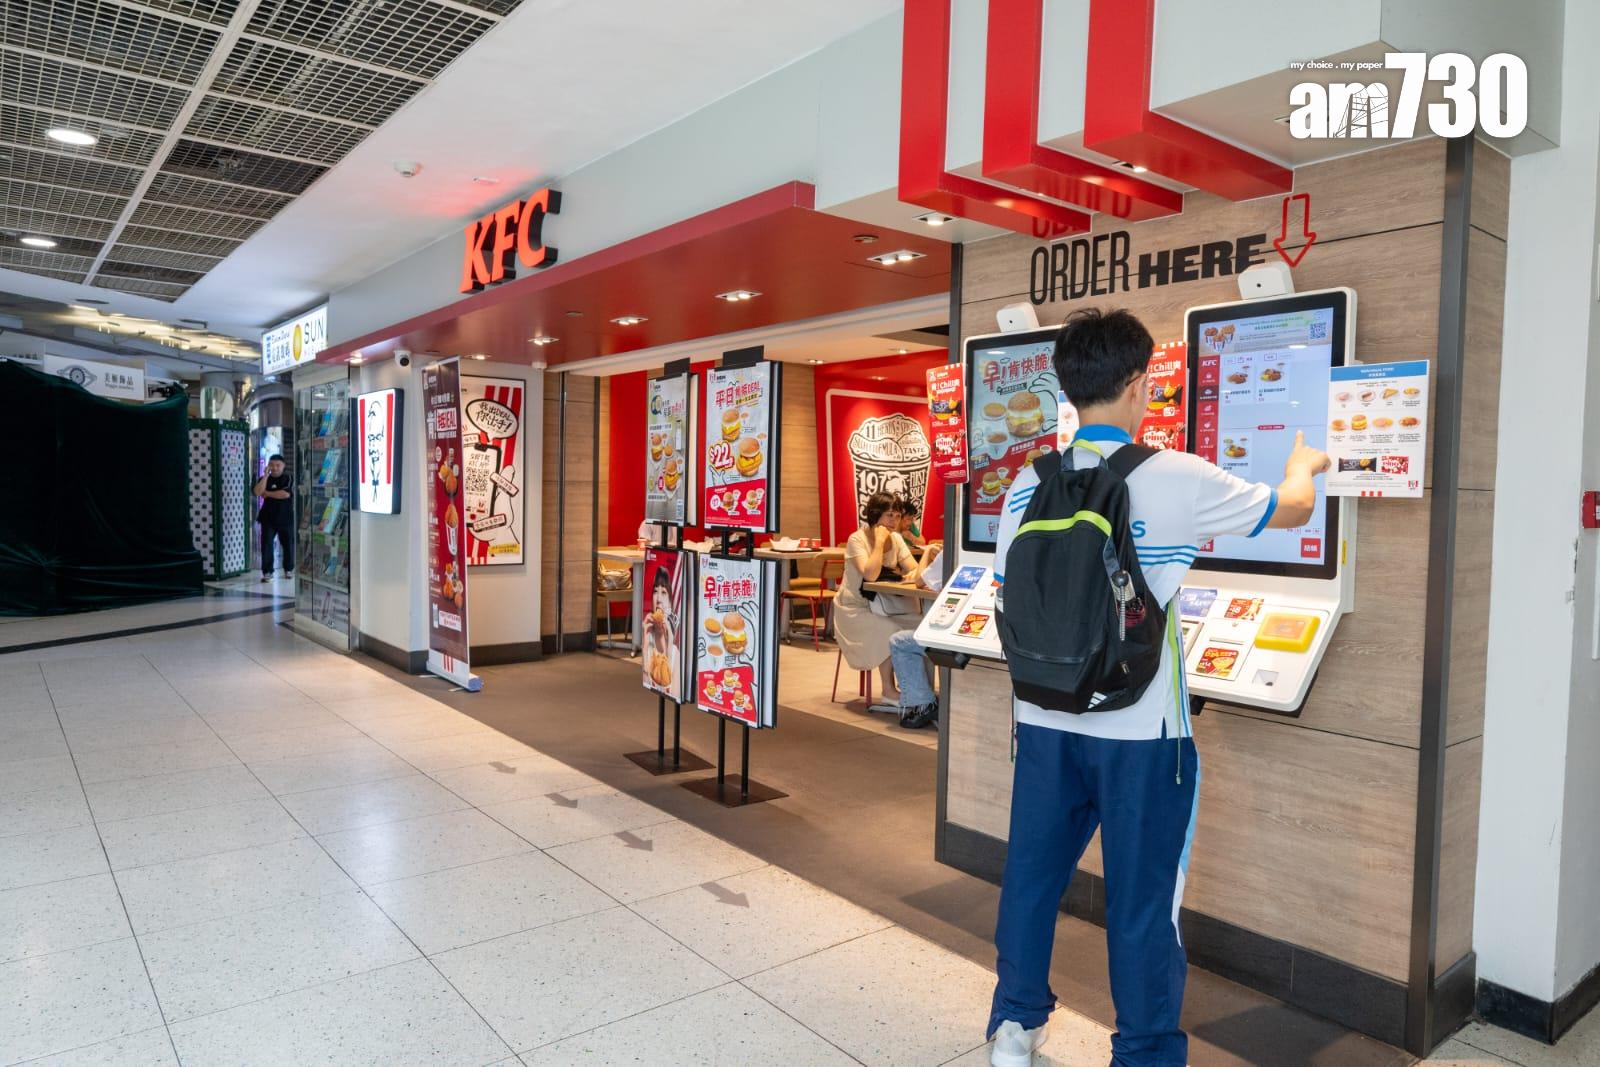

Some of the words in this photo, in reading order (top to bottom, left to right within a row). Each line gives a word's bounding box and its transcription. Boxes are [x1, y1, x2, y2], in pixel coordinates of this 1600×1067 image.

[459, 187, 561, 293] KFC
[1030, 231, 1131, 305] ORDER
[1138, 233, 1267, 289] HERE
[304, 316, 325, 345] SUN
